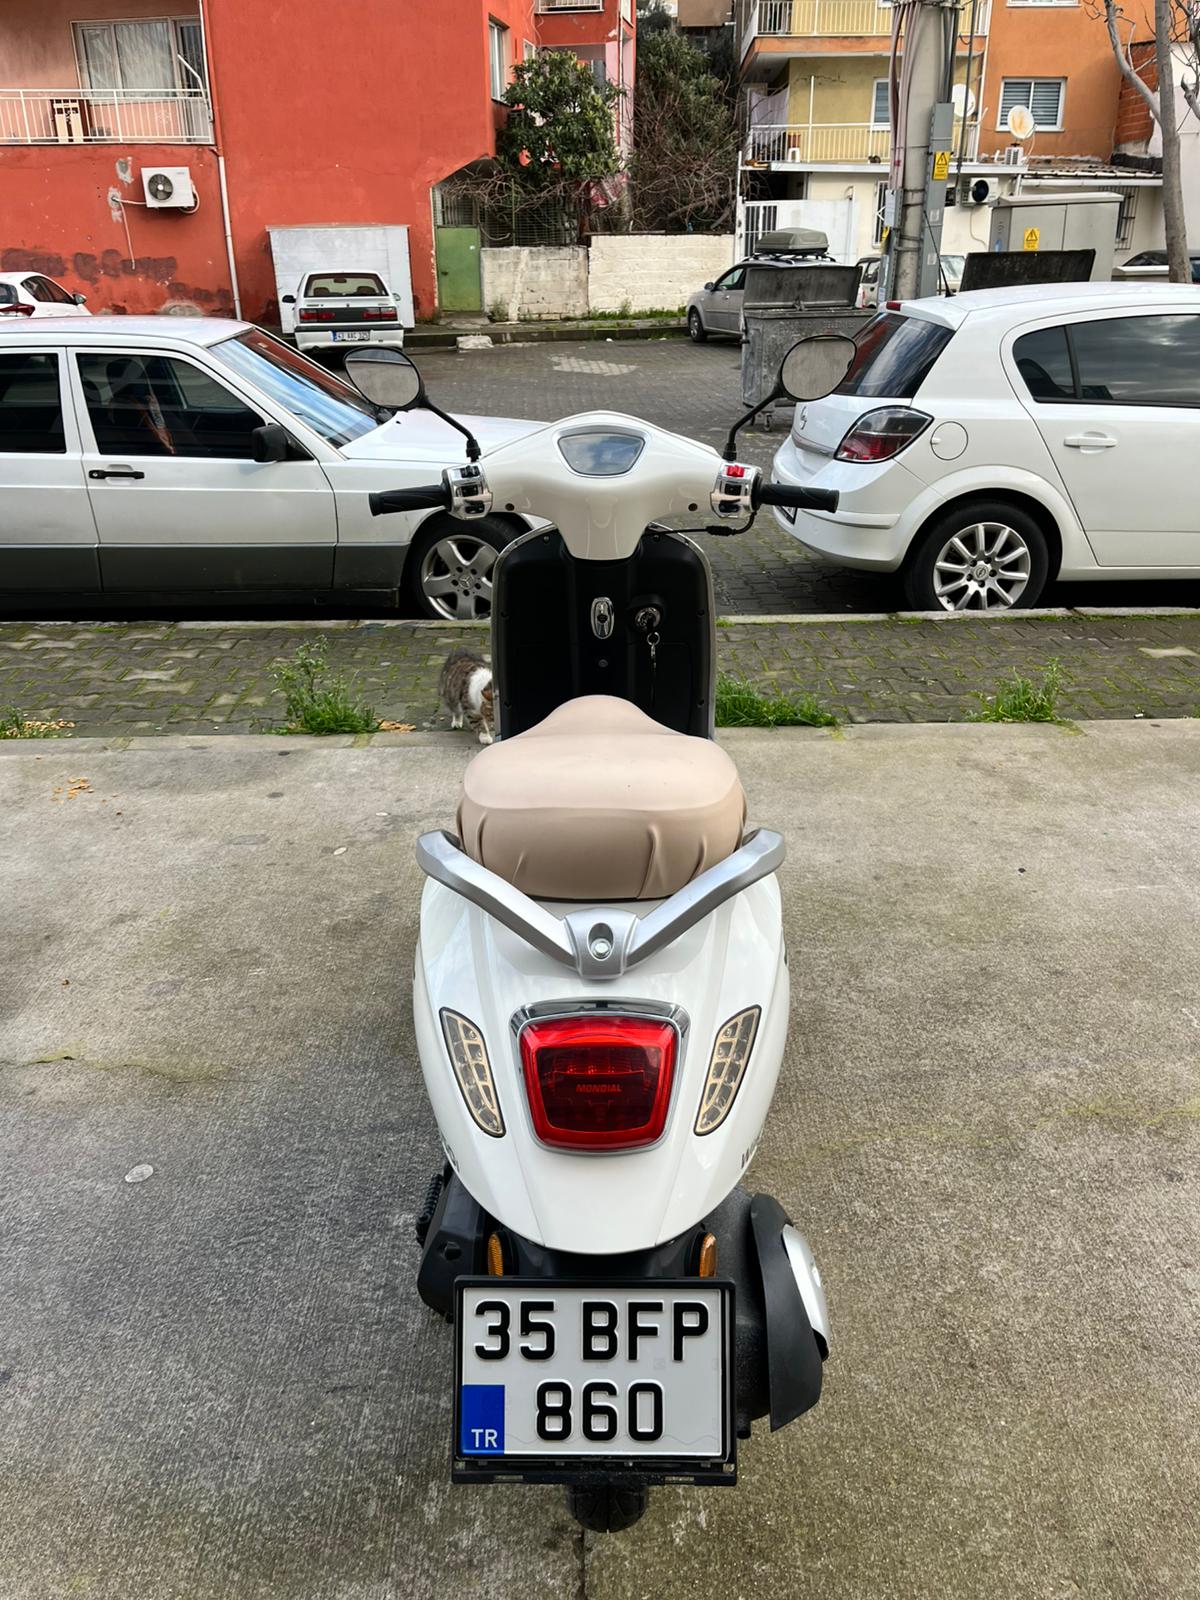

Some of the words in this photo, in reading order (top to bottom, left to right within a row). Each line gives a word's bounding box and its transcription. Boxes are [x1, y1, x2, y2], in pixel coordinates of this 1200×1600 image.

[576, 1084, 622, 1093] MONDIAL
[475, 1300, 555, 1361] 35
[582, 1300, 709, 1361] BFP
[536, 1380, 664, 1442] 860
[471, 1429, 498, 1448] TR
